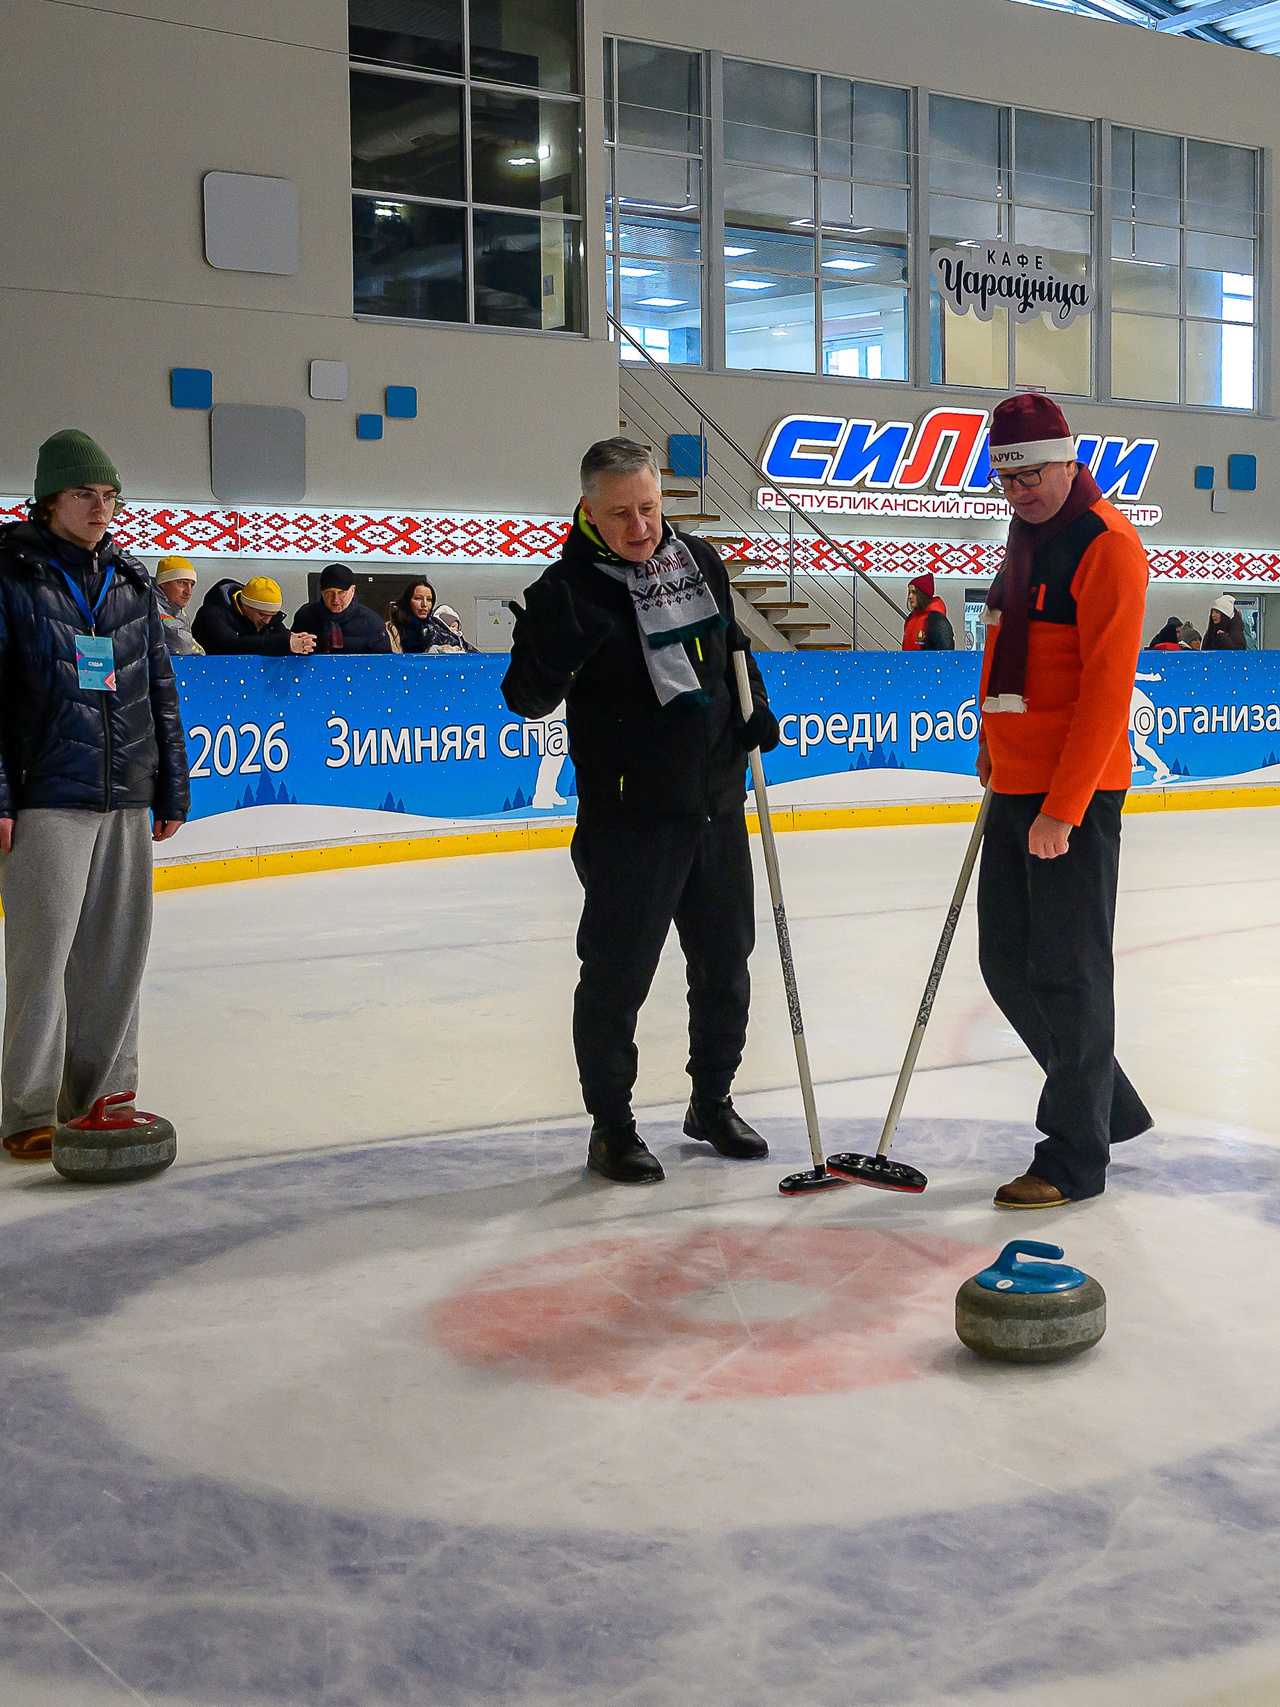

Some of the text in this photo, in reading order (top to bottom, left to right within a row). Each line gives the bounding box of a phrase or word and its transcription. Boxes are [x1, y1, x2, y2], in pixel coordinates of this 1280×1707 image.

[988, 250, 1042, 270] КАФЕ
[938, 258, 1089, 320] Чараўніца
[762, 492, 1159, 521] РЕСПУБЛИКАНСКИЙ ГОРН ЕНТР
[633, 550, 689, 580] ЕДИНЫЕ
[965, 604, 984, 613] ИЧИ
[325, 716, 486, 769] Зимняя
[498, 720, 569, 758] спа
[778, 713, 898, 757] среди
[909, 698, 983, 752] раб
[188, 721, 289, 778] 2026
